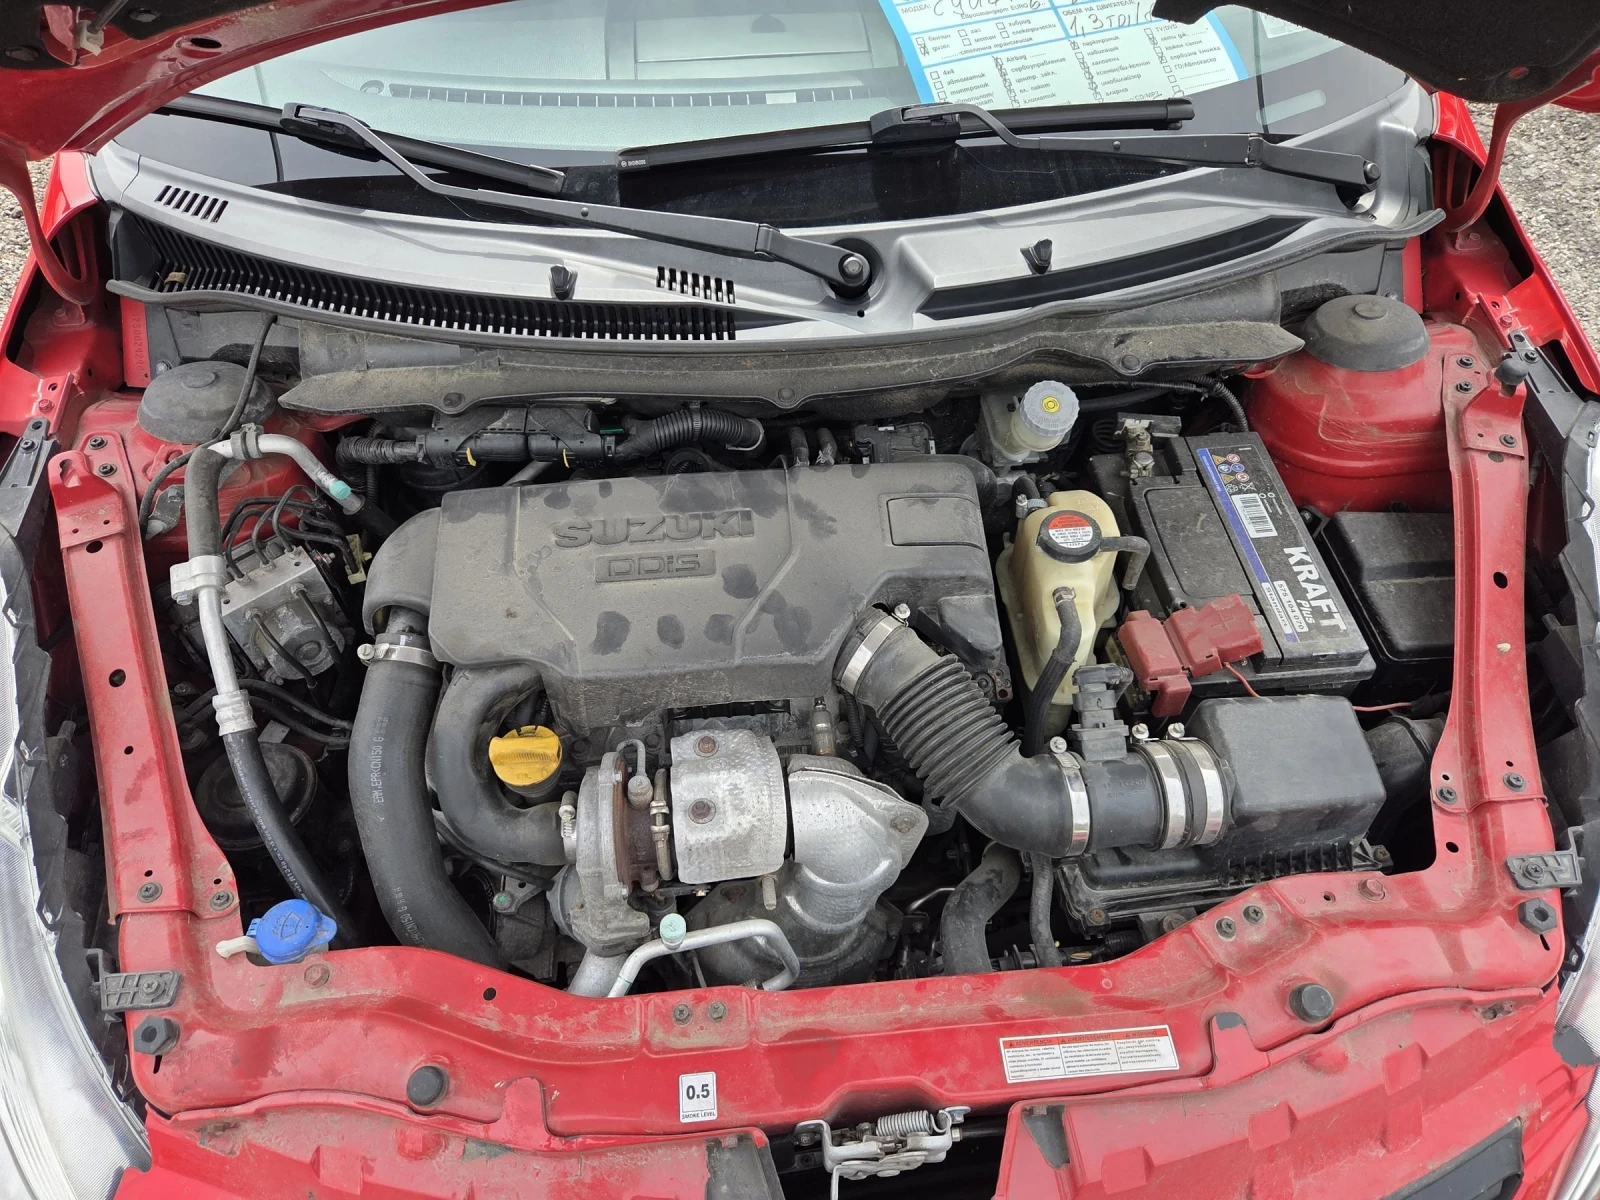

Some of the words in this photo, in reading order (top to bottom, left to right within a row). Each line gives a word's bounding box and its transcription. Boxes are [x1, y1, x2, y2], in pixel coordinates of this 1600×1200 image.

[1010, 3, 1028, 11] EURO
[1062, 8, 1083, 16] ОБЕМ
[1008, 19, 1031, 27] хибрид
[1012, 23, 1057, 35] електрически
[1155, 24, 1177, 32] TV/DVD
[974, 35, 997, 43] метан
[994, 36, 1033, 48] трансмисия
[1082, 35, 1120, 46] парктроник
[932, 44, 950, 52] дизел
[1087, 46, 1119, 56] навигация
[1011, 57, 1066, 73] сервоуправление
[947, 72, 986, 85] автоматик
[951, 82, 989, 95] типтроник
[1031, 83, 1051, 91] пакет
[1105, 87, 1129, 96] аларма
[553, 508, 755, 548] SUZUKI
[1283, 547, 1348, 631] KRAFT
[1264, 586, 1288, 627] Standart
[1277, 582, 1288, 597] 575
[1285, 599, 1296, 613] 104
[1293, 614, 1304, 630] 070
[1297, 599, 1316, 625] Plus
[686, 1084, 710, 1100] 0.5
